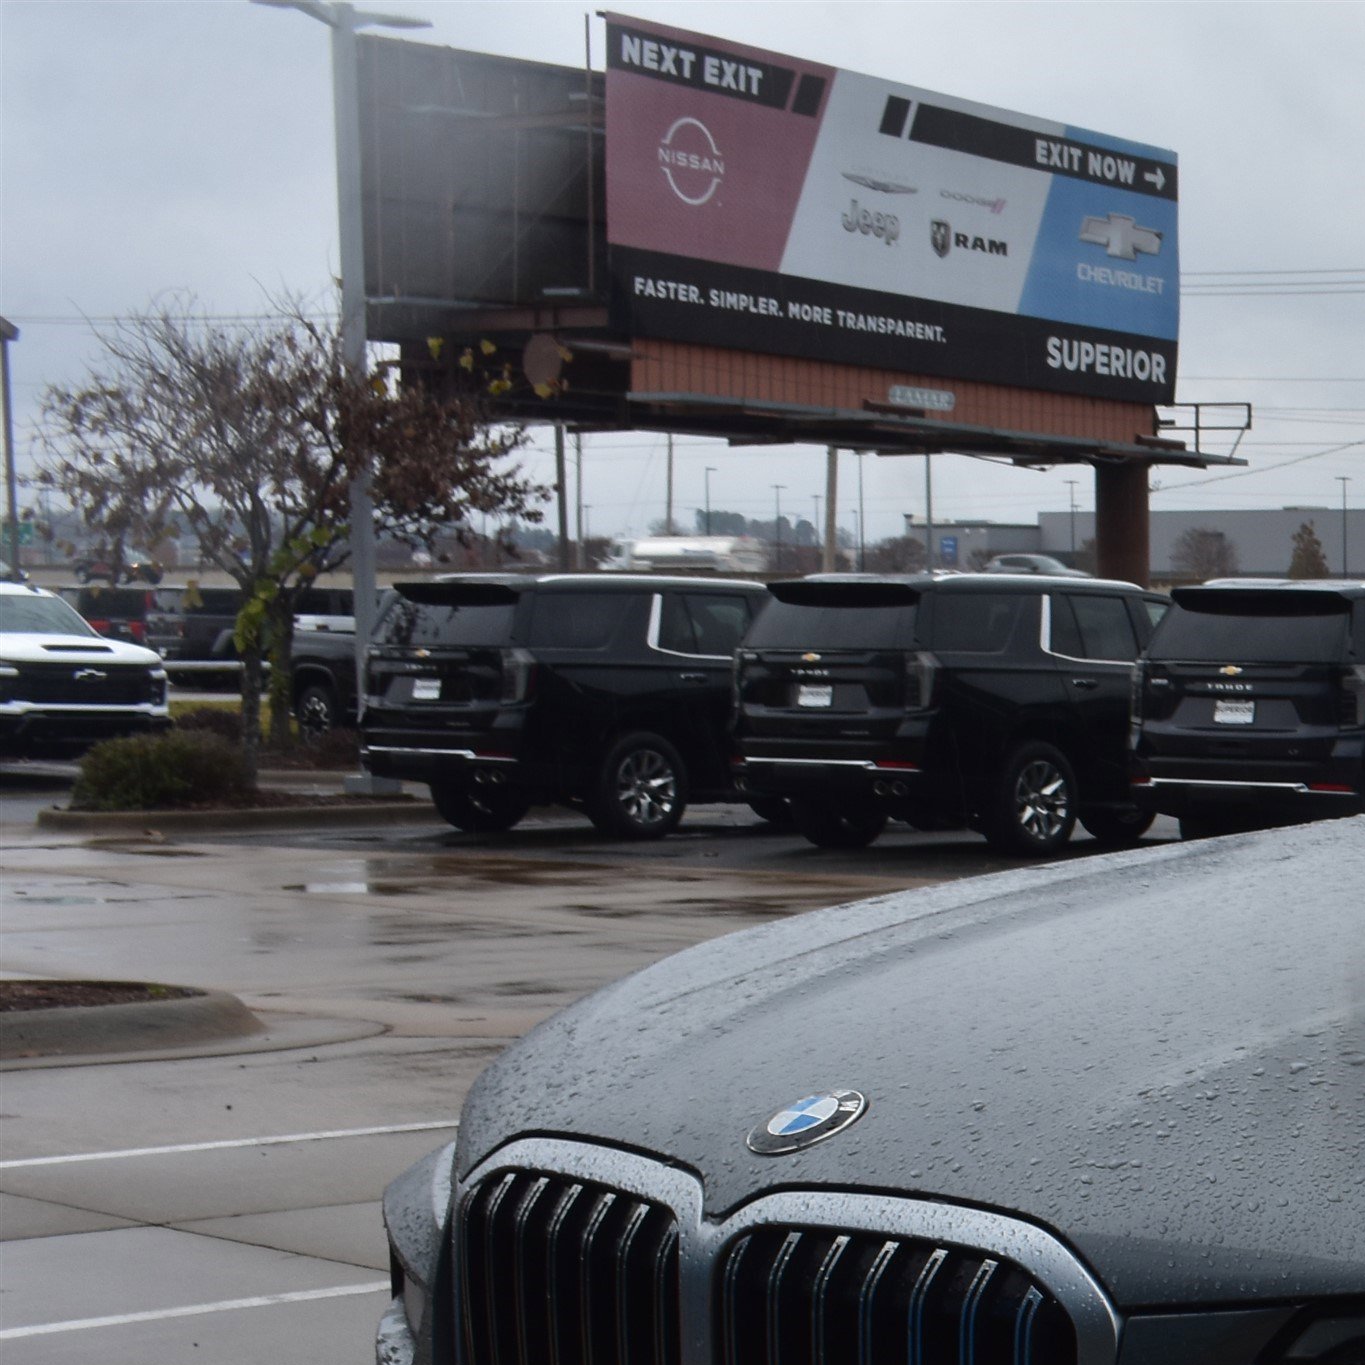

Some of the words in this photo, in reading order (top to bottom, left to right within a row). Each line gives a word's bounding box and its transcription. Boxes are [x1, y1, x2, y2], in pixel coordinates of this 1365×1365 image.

[621, 33, 696, 79] NEXT
[703, 55, 763, 96] EXIT
[658, 148, 725, 175] NISSAN
[1035, 139, 1082, 172] EXIT
[1088, 154, 1136, 185] NOW
[842, 199, 900, 246] Jeep
[954, 231, 1008, 257] RAM
[1076, 262, 1165, 295] CHEVROLET
[634, 276, 704, 305] FASTER.
[709, 289, 783, 318] SIMPLER.
[788, 302, 832, 326] MORE
[836, 310, 947, 344] TRANSPARENT.
[1046, 336, 1167, 384] SUPERIOR
[1207, 682, 1254, 691] TAHOE
